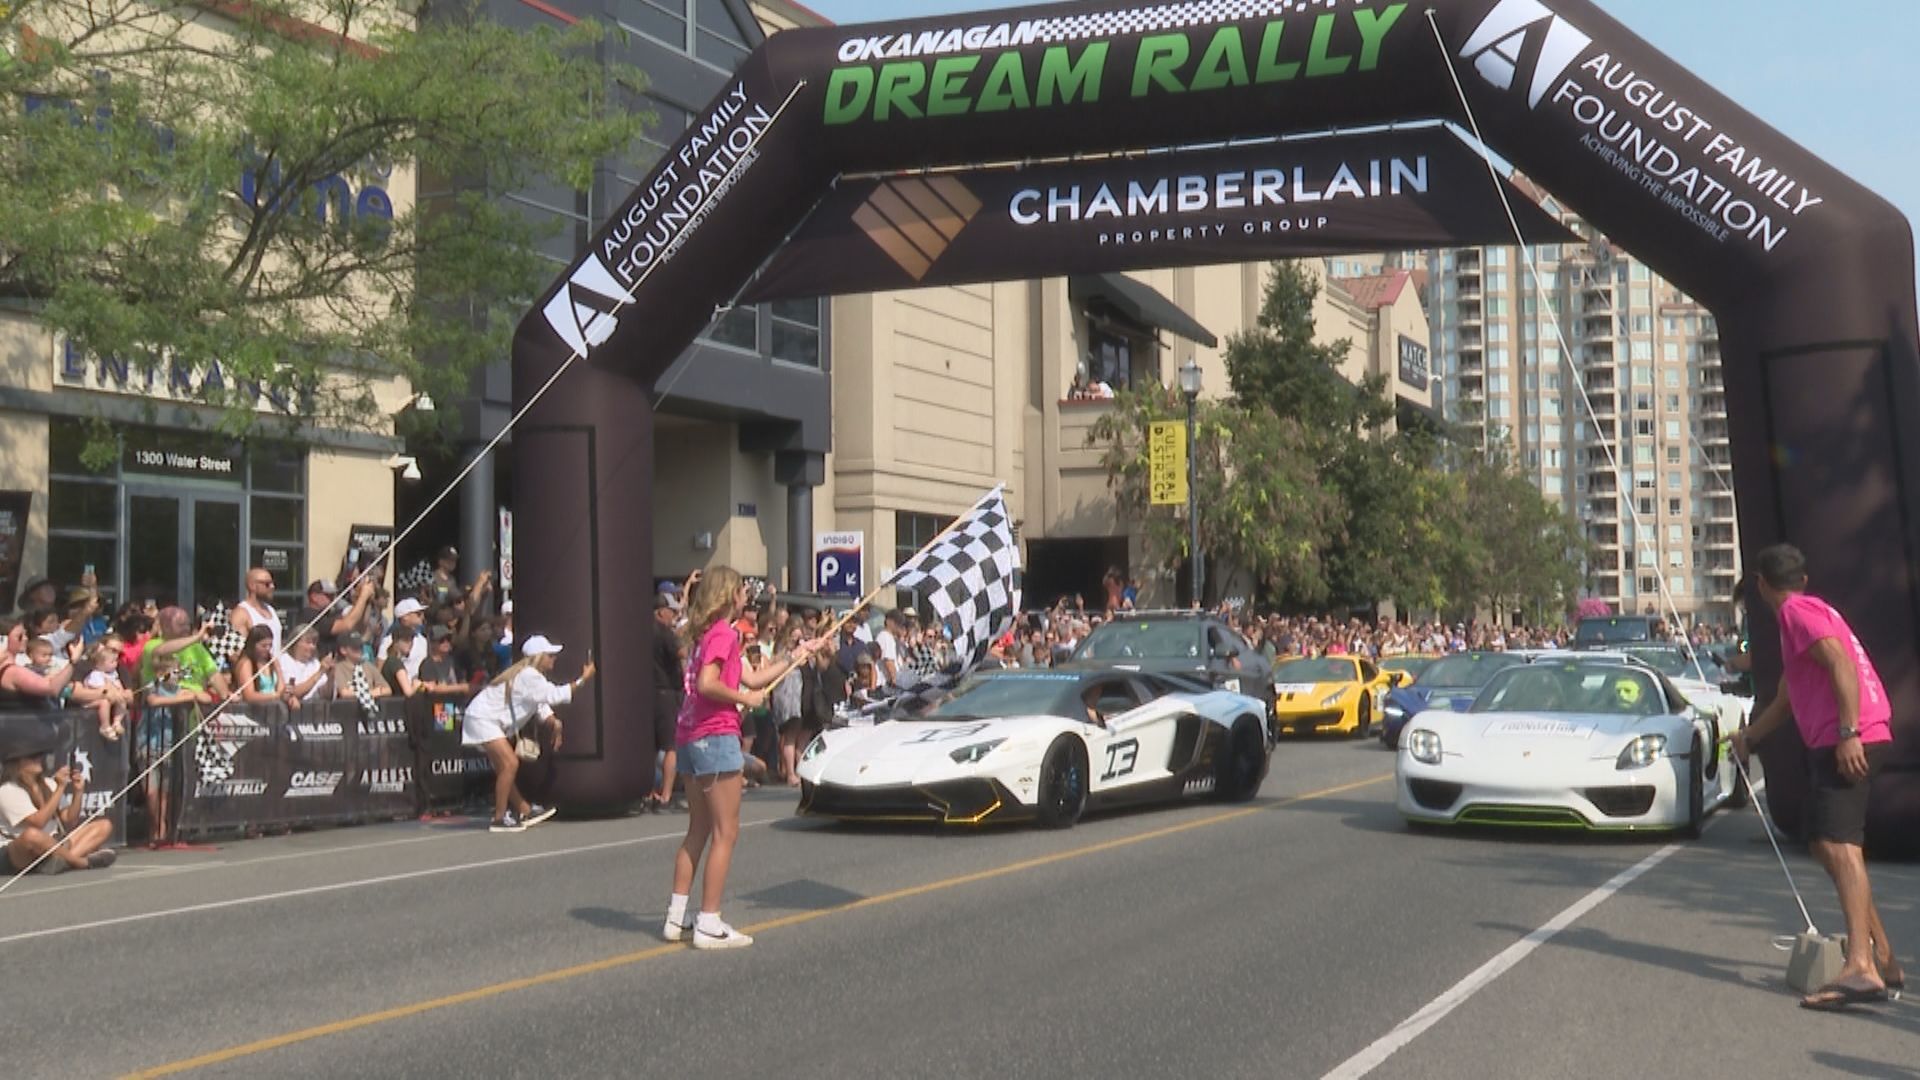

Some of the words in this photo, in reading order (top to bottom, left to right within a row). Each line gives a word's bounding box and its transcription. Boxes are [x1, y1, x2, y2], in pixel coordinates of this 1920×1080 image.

[823, 41, 1110, 125] DREAM
[1130, 4, 1408, 97] RALLY
[837, 19, 1042, 62] OKANAGAN
[1580, 52, 1712, 142] AUGUST
[1703, 133, 1823, 216] FAMILY
[602, 161, 680, 260] AUGUST
[678, 81, 749, 167] FAMILY
[616, 103, 772, 284] FOUNDATION
[1008, 156, 1429, 226] CHAMBERLAIN
[1552, 79, 1788, 252] FOUNDATION
[1579, 134, 1643, 186] ACHIEVING
[1638, 174, 1663, 197] THE
[1659, 191, 1730, 243] IMPOSSIBLE
[1099, 223, 1226, 246] PROPERTY
[1243, 215, 1329, 234] GROUP
[135, 450, 165, 466] 1300
[165, 452, 198, 469] Water
[199, 455, 232, 473] Street
[820, 556, 840, 587] P
[290, 771, 344, 788] CASE
[360, 767, 413, 785] AUGUST
[1100, 737, 1140, 782] 13
